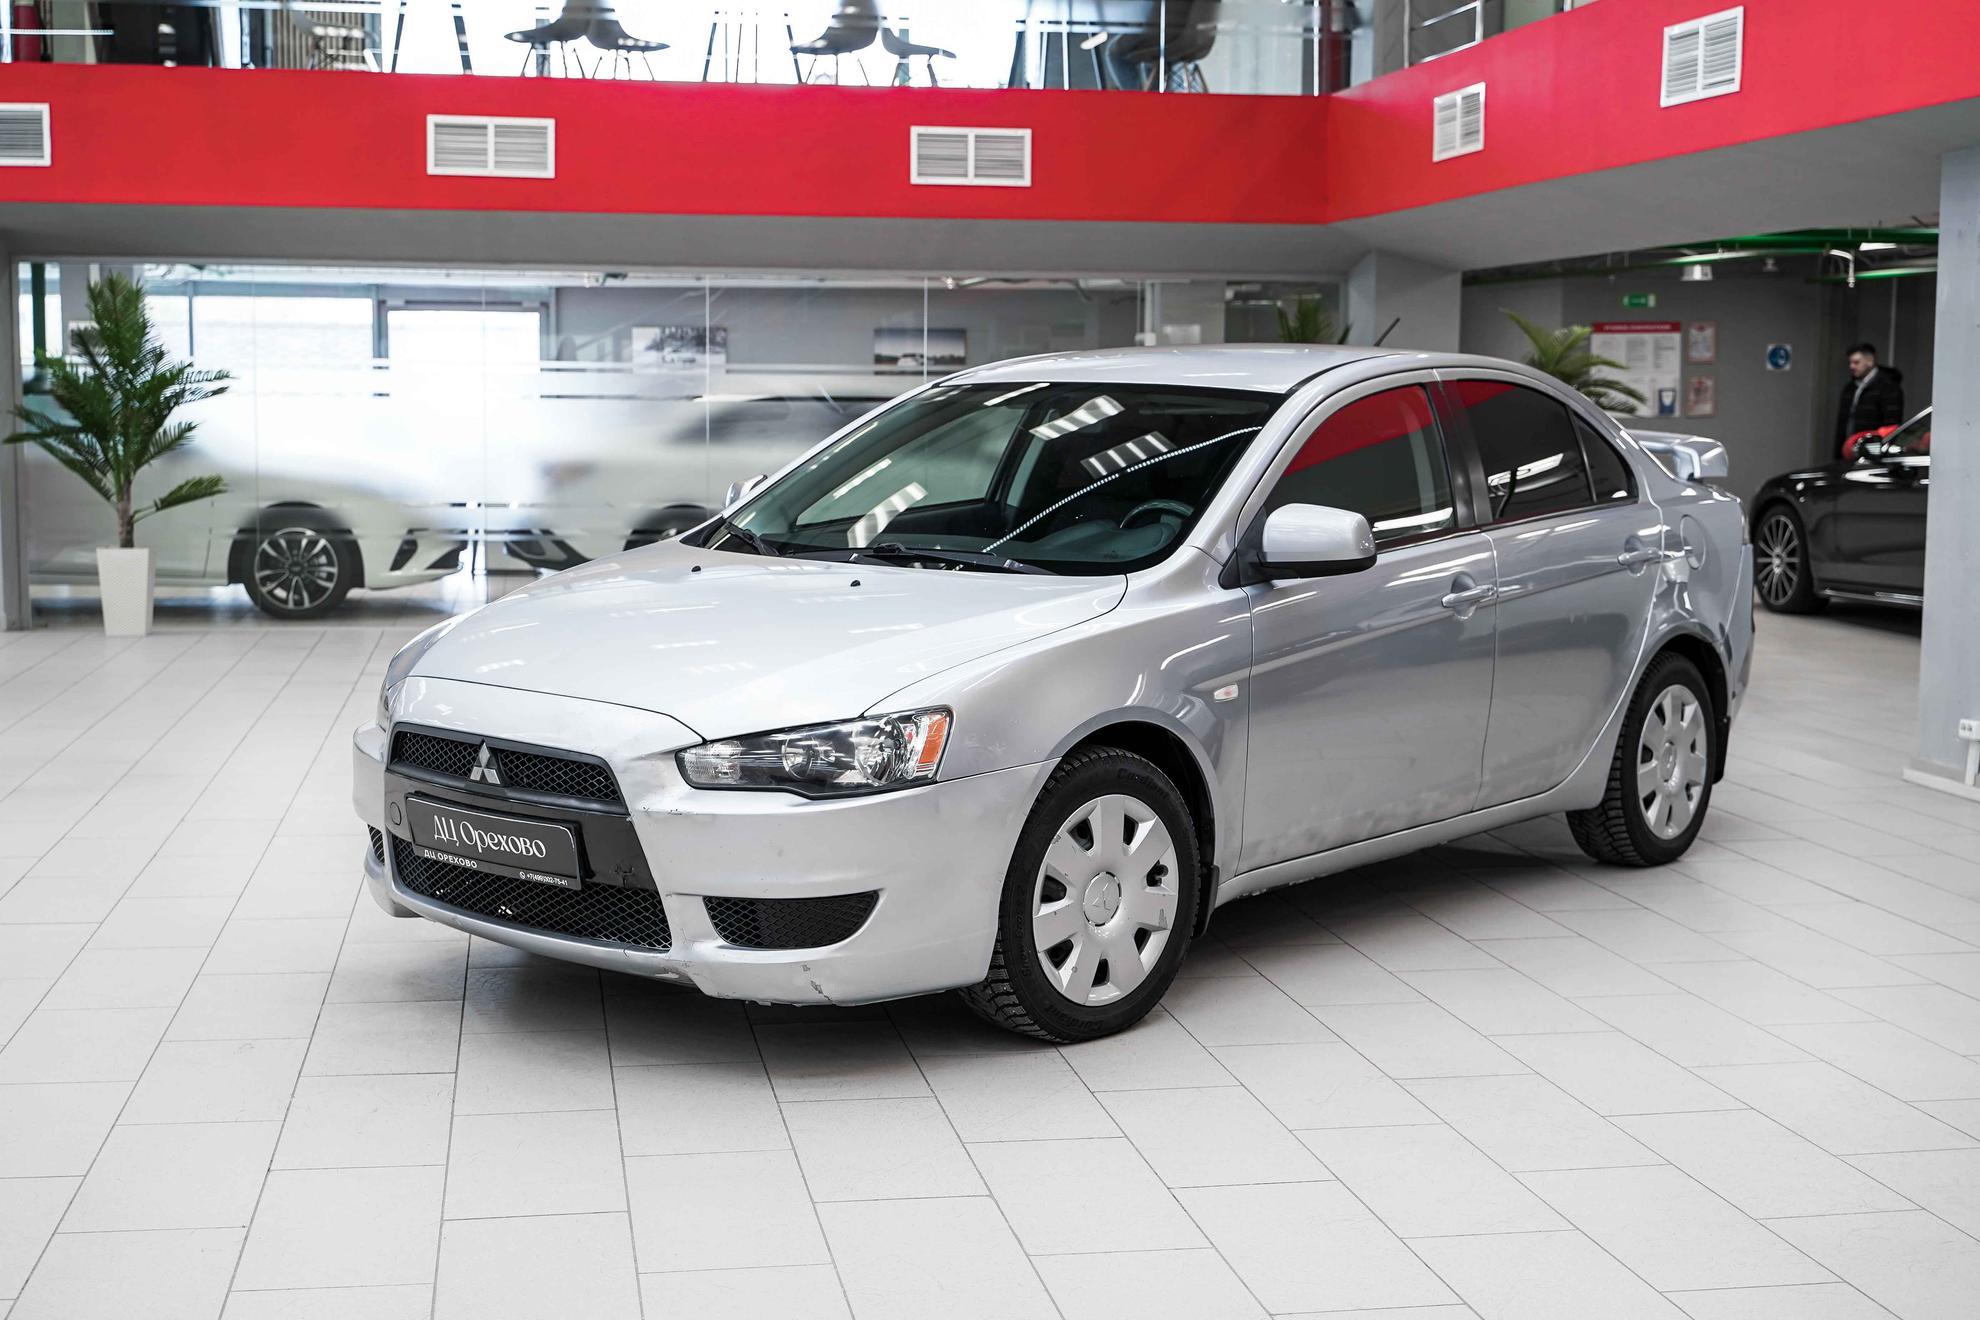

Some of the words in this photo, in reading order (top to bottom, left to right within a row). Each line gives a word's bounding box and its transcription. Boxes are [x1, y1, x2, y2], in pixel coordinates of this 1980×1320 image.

[433, 815, 460, 847] ДЦ
[460, 821, 547, 858] Орехово
[424, 849, 437, 860] ДЦ
[438, 853, 478, 869] ОРЕХОВО
